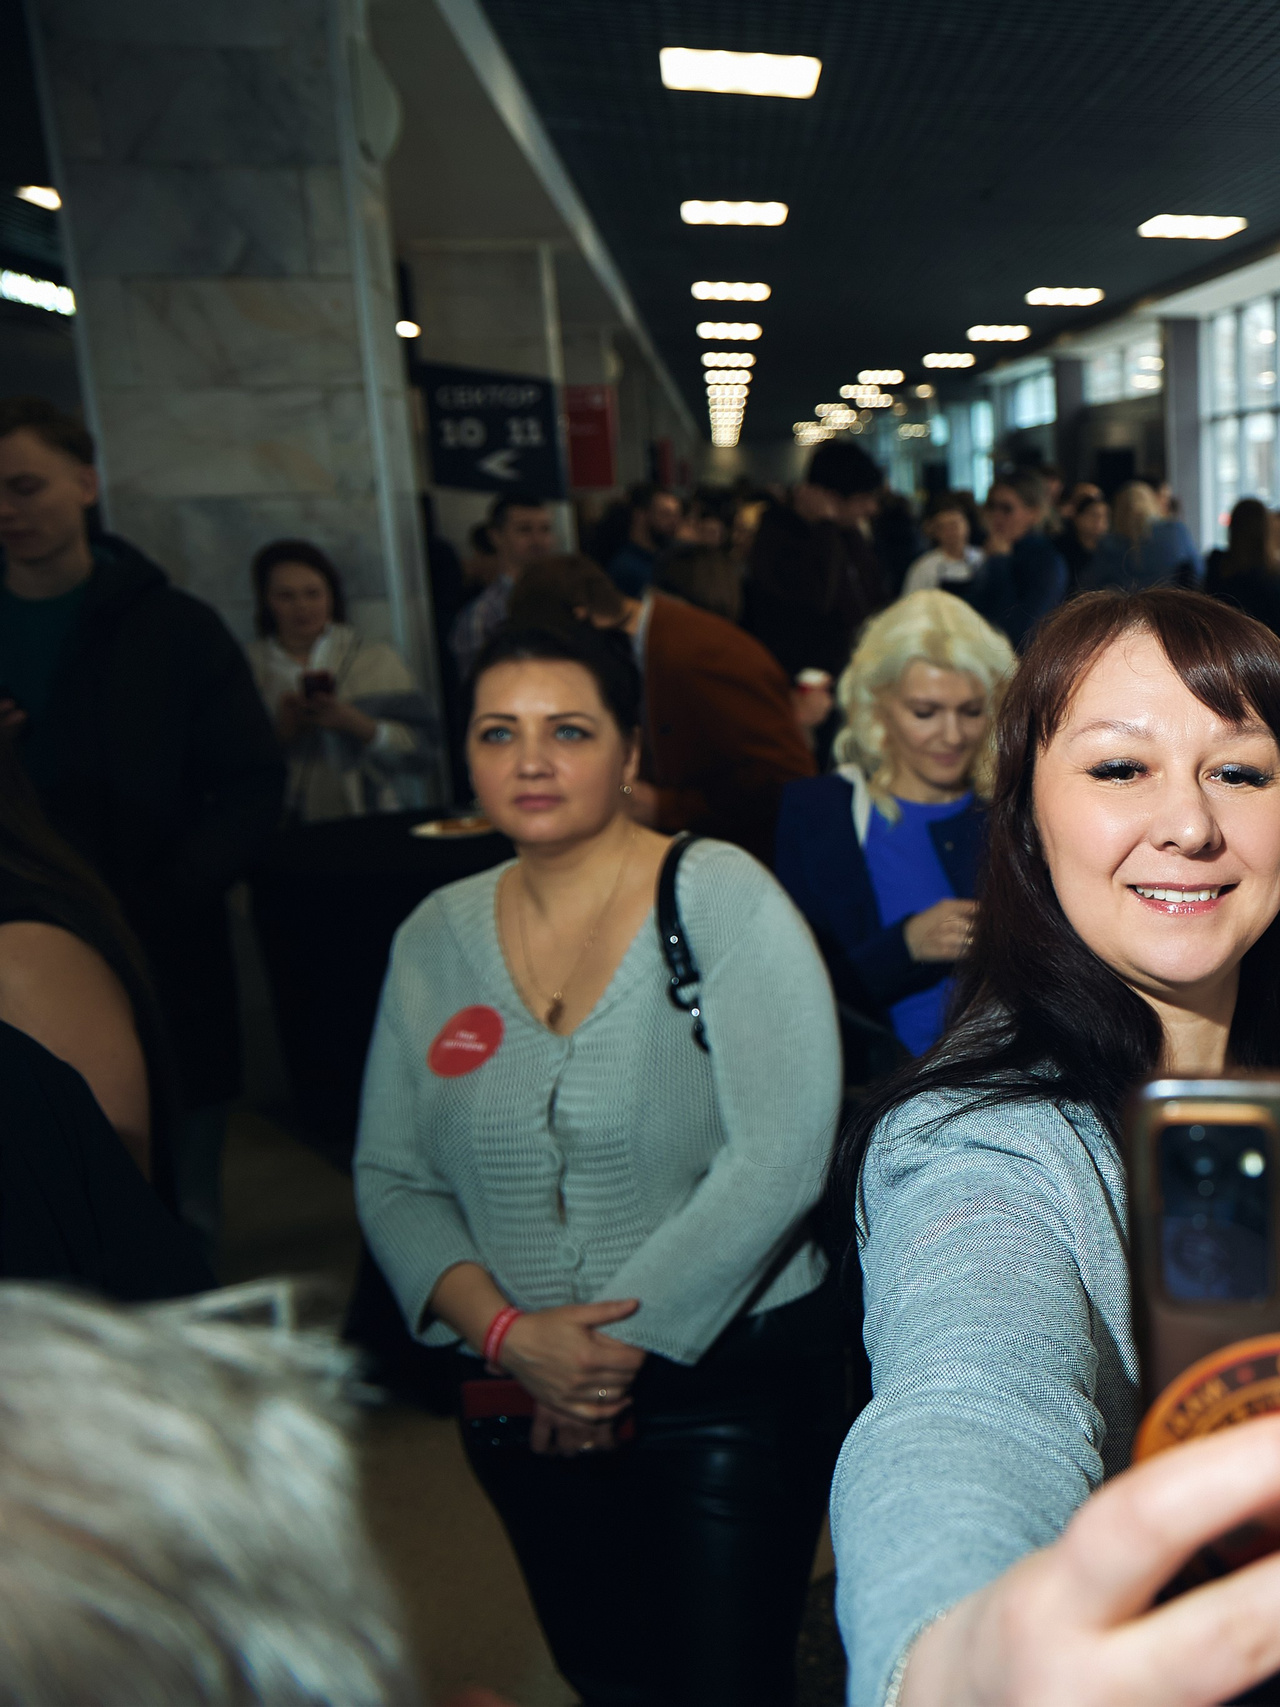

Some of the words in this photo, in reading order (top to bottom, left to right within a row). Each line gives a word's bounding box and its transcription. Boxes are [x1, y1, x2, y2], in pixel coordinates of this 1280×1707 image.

[436, 384, 542, 409] СЕКТОР
[440, 417, 486, 448] 10
[507, 416, 545, 446] 11
